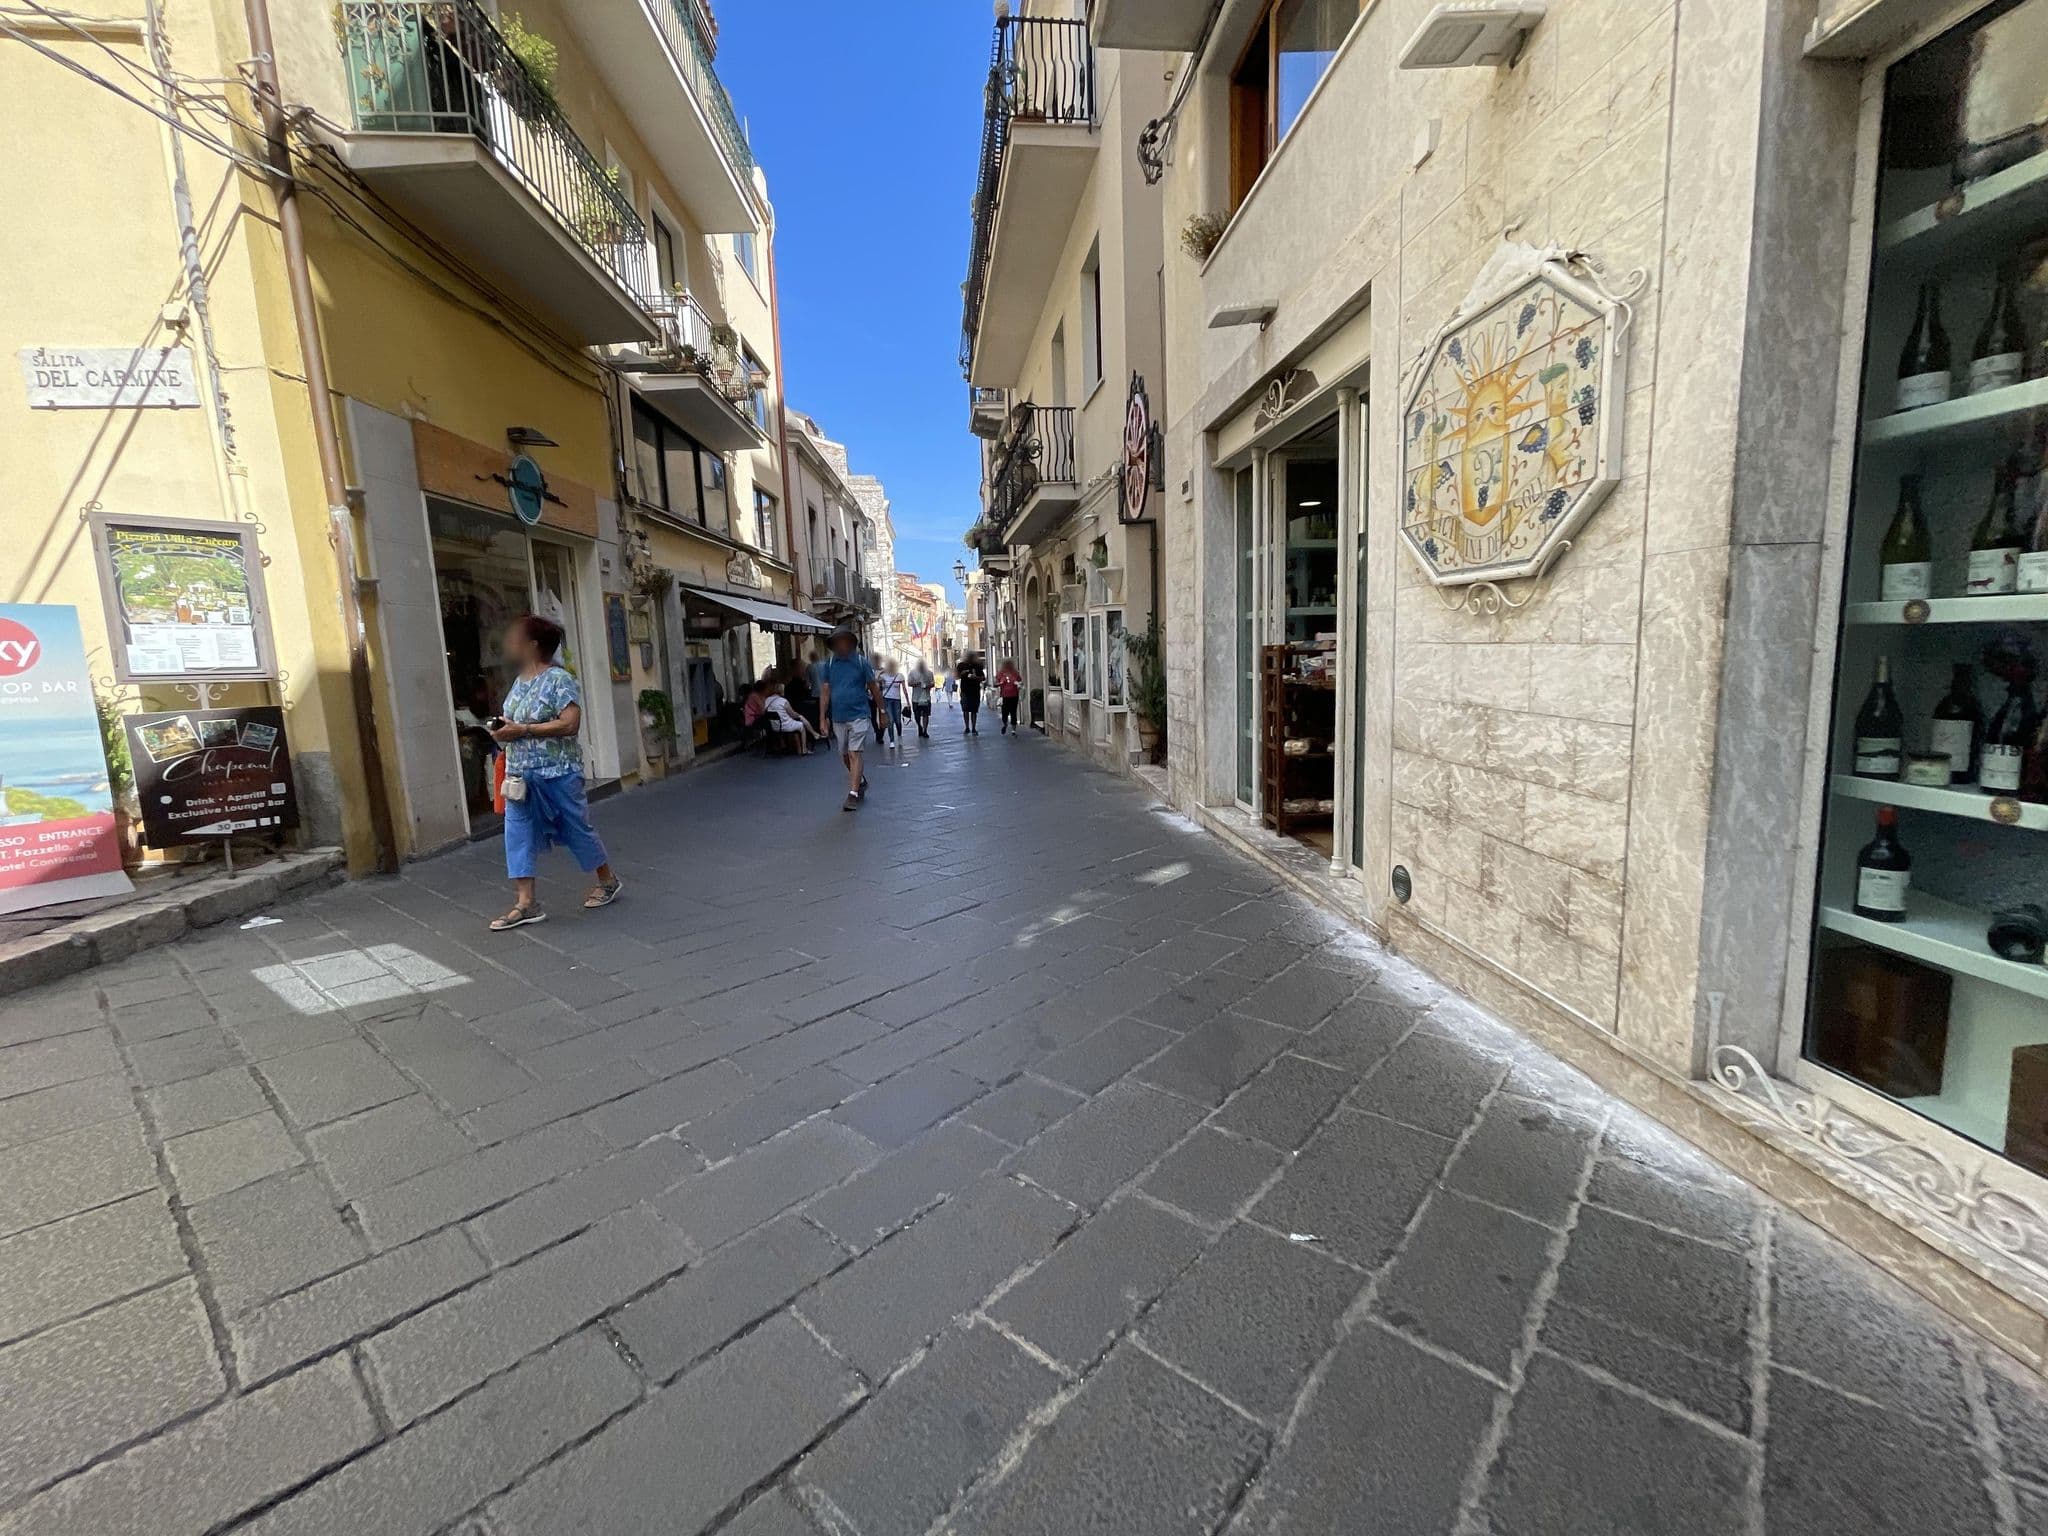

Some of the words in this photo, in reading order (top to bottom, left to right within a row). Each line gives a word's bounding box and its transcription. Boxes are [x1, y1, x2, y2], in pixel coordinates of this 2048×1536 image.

[32, 355, 85, 368] SALITA
[36, 370, 79, 388] DEL
[86, 369, 183, 388] CARMINE
[116, 531, 161, 542] Pizzeria
[0, 681, 33, 695] OP
[41, 680, 78, 694] BAR
[186, 795, 216, 807] Drink
[168, 807, 222, 819] Exclusive
[225, 802, 265, 813] Lounge
[268, 799, 286, 807] Bar
[39, 826, 104, 842] ENTRANCE
[217, 823, 231, 831] 30
[30, 851, 97, 868] Continental
